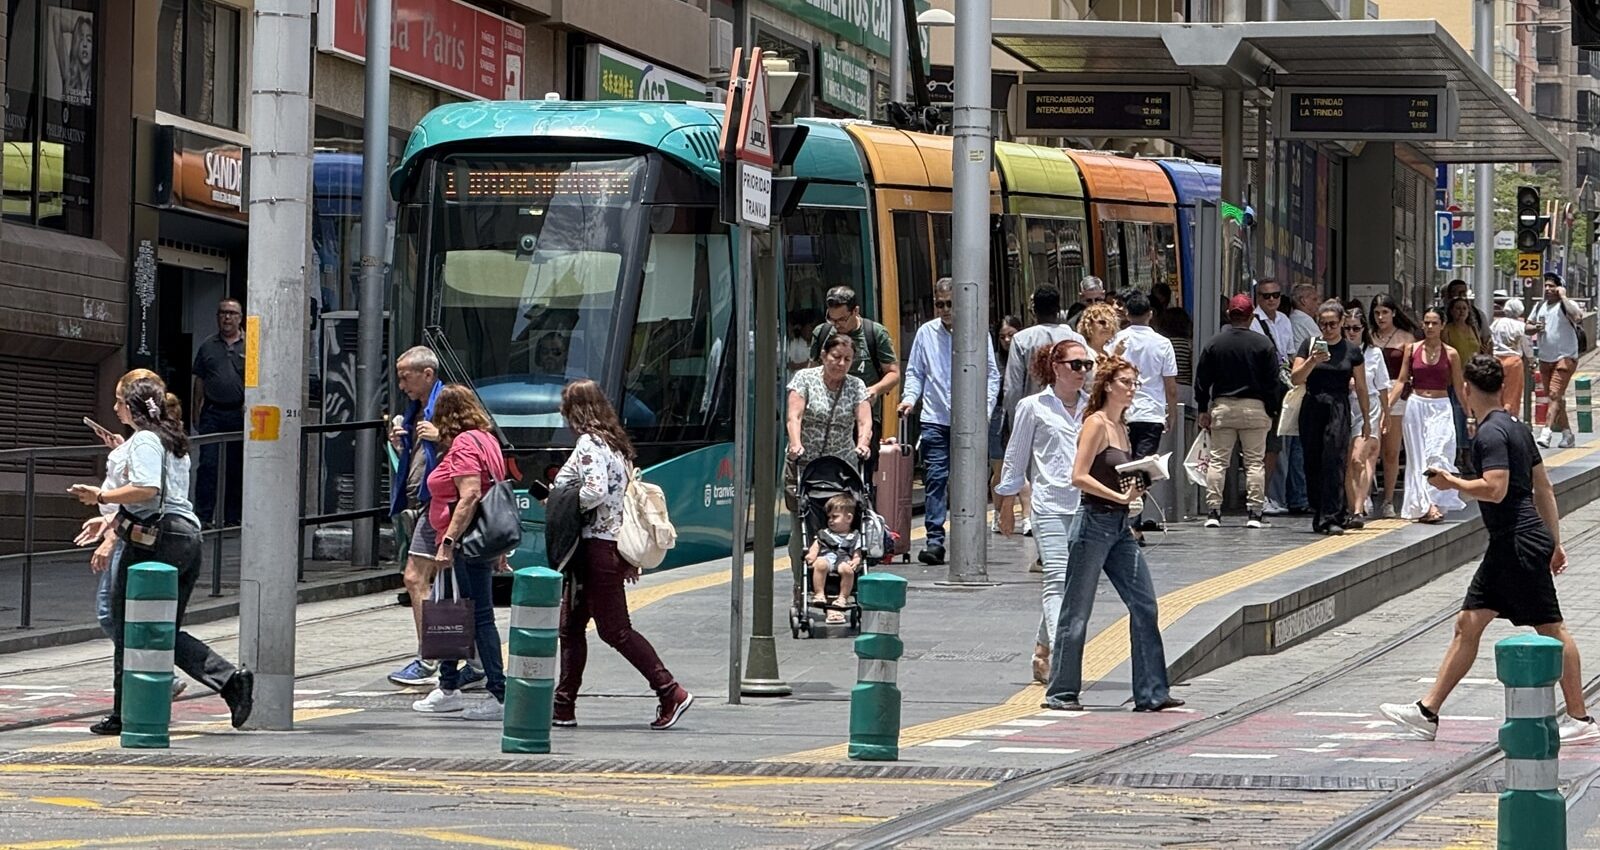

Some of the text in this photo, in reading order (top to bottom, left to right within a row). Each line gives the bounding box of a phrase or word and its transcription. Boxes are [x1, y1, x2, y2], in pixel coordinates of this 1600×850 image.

[422, 10, 465, 71] Paris
[1036, 95, 1095, 104] INTERCAMBIADOR
[1299, 97, 1429, 107] LA TRINIDAD 7 min
[1035, 106, 1095, 114] INTERCAMBIADOR
[1150, 107, 1162, 115] min
[1299, 108, 1310, 117] LA
[1313, 108, 1344, 117] TRINIDAD
[1417, 110, 1429, 118] min
[743, 172, 771, 195] PRIORIDAD
[1439, 216, 1450, 246] P
[1519, 258, 1539, 271] 25
[857, 360, 866, 374] 4
[254, 411, 271, 433] T
